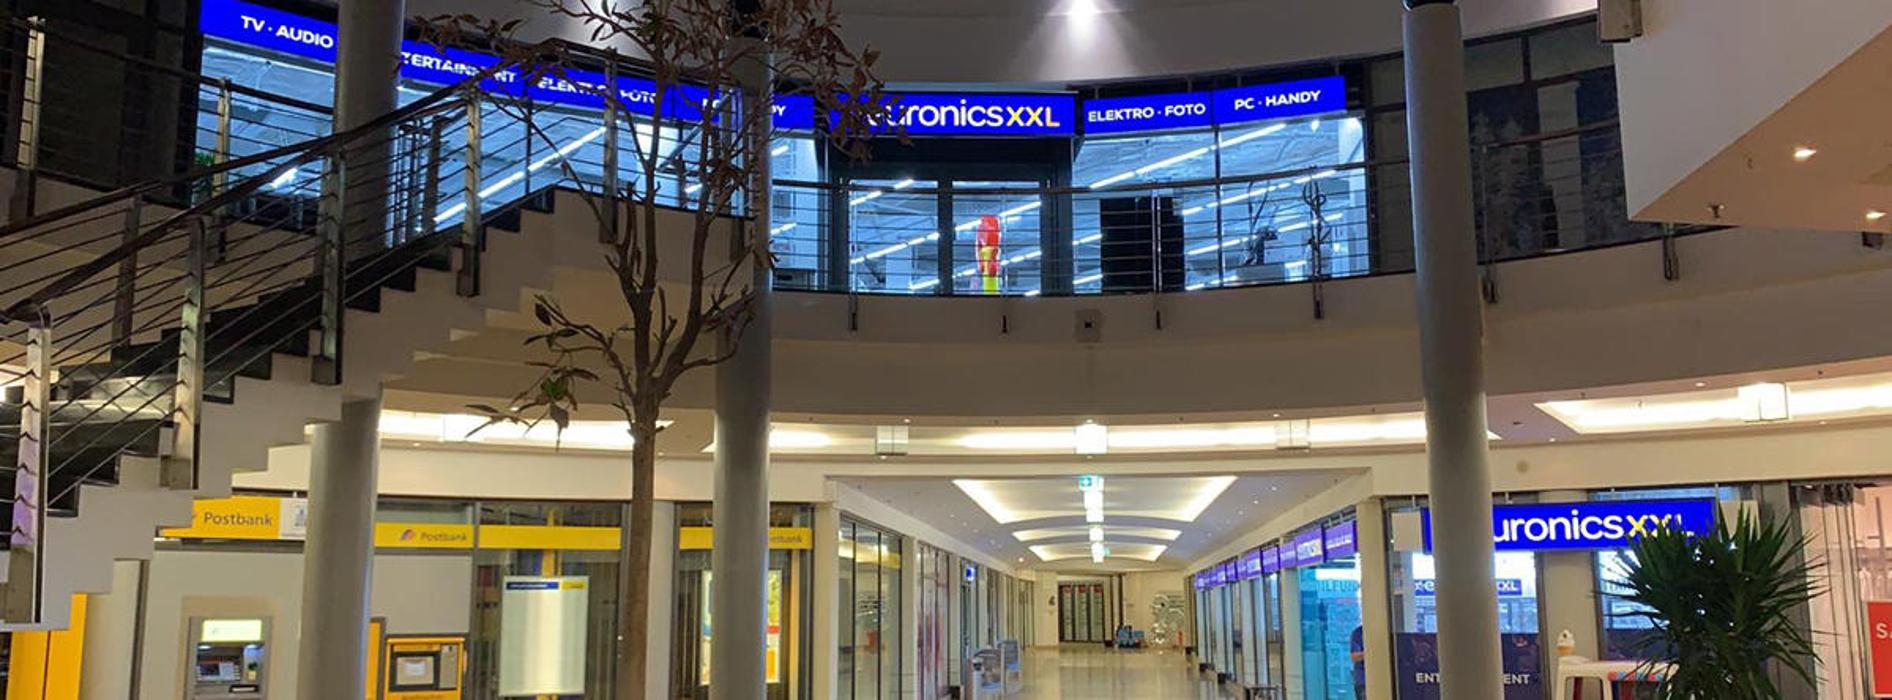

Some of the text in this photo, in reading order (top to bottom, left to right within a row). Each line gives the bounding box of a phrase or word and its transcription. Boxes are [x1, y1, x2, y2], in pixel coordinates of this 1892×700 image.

[240, 15, 334, 49] TV AUDIO
[1233, 89, 1322, 111] PC HANDY
[1087, 102, 1207, 122] ELEKTRO FOTO
[203, 511, 272, 527] Postbank
[1493, 508, 1695, 543] uronicsXXL
